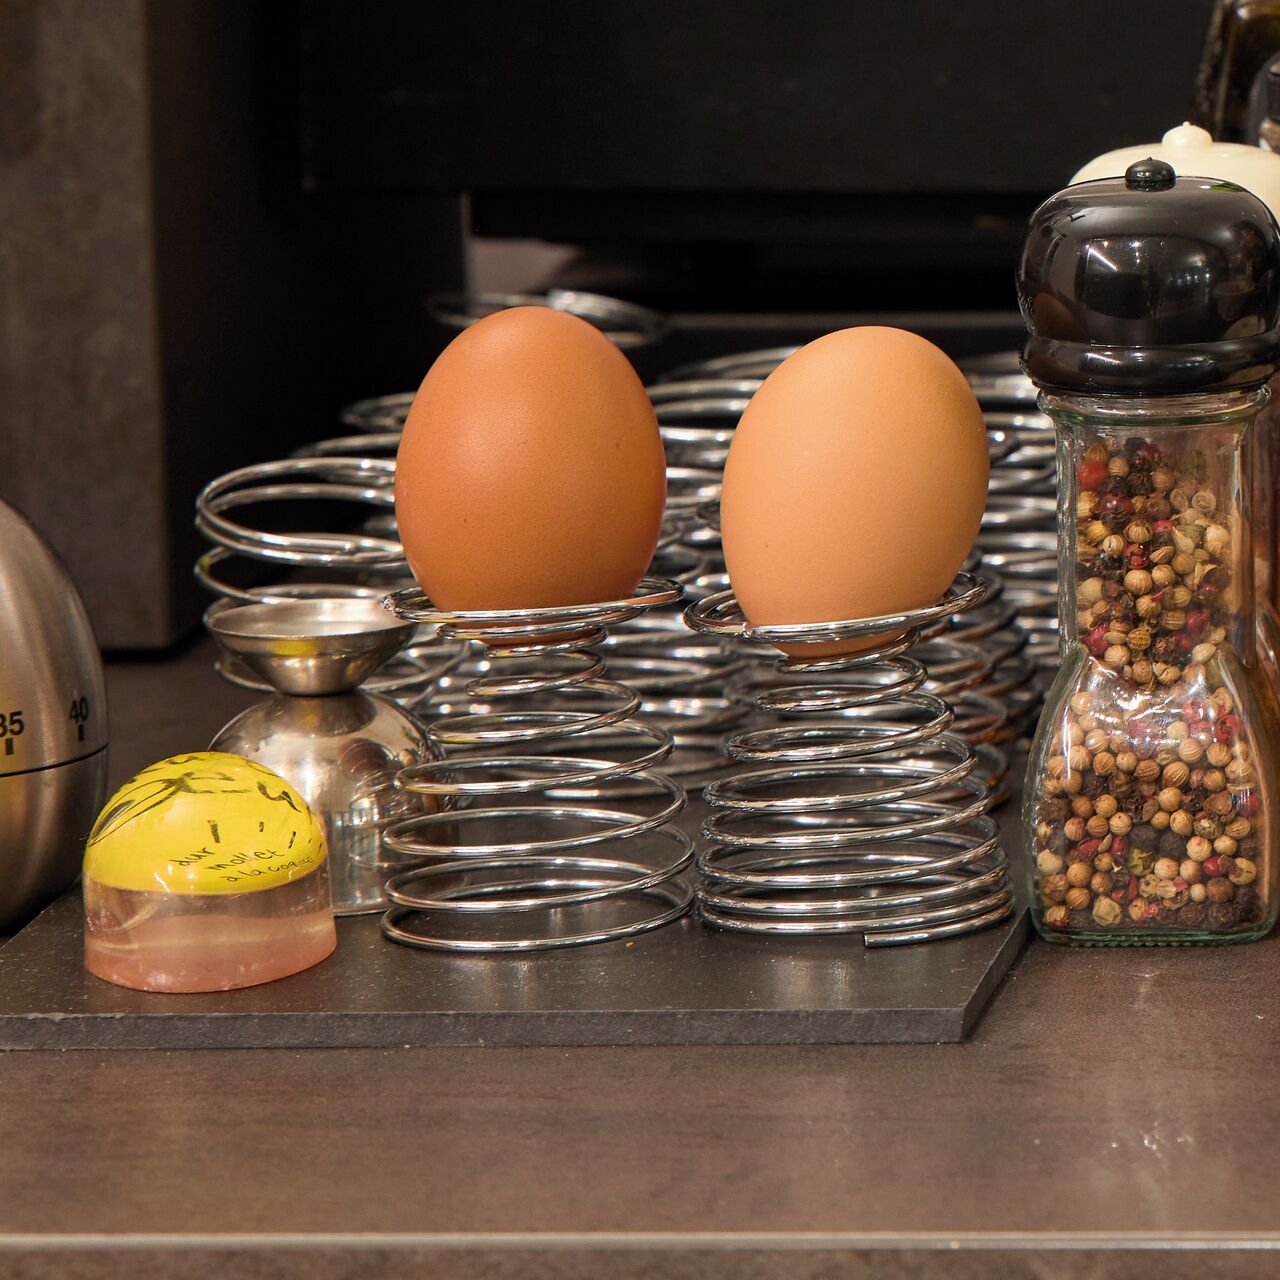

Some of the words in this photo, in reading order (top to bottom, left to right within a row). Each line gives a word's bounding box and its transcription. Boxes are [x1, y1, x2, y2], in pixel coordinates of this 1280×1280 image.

[70, 697, 89, 724] 40
[168, 847, 215, 867] dur
[204, 849, 285, 871] mollet
